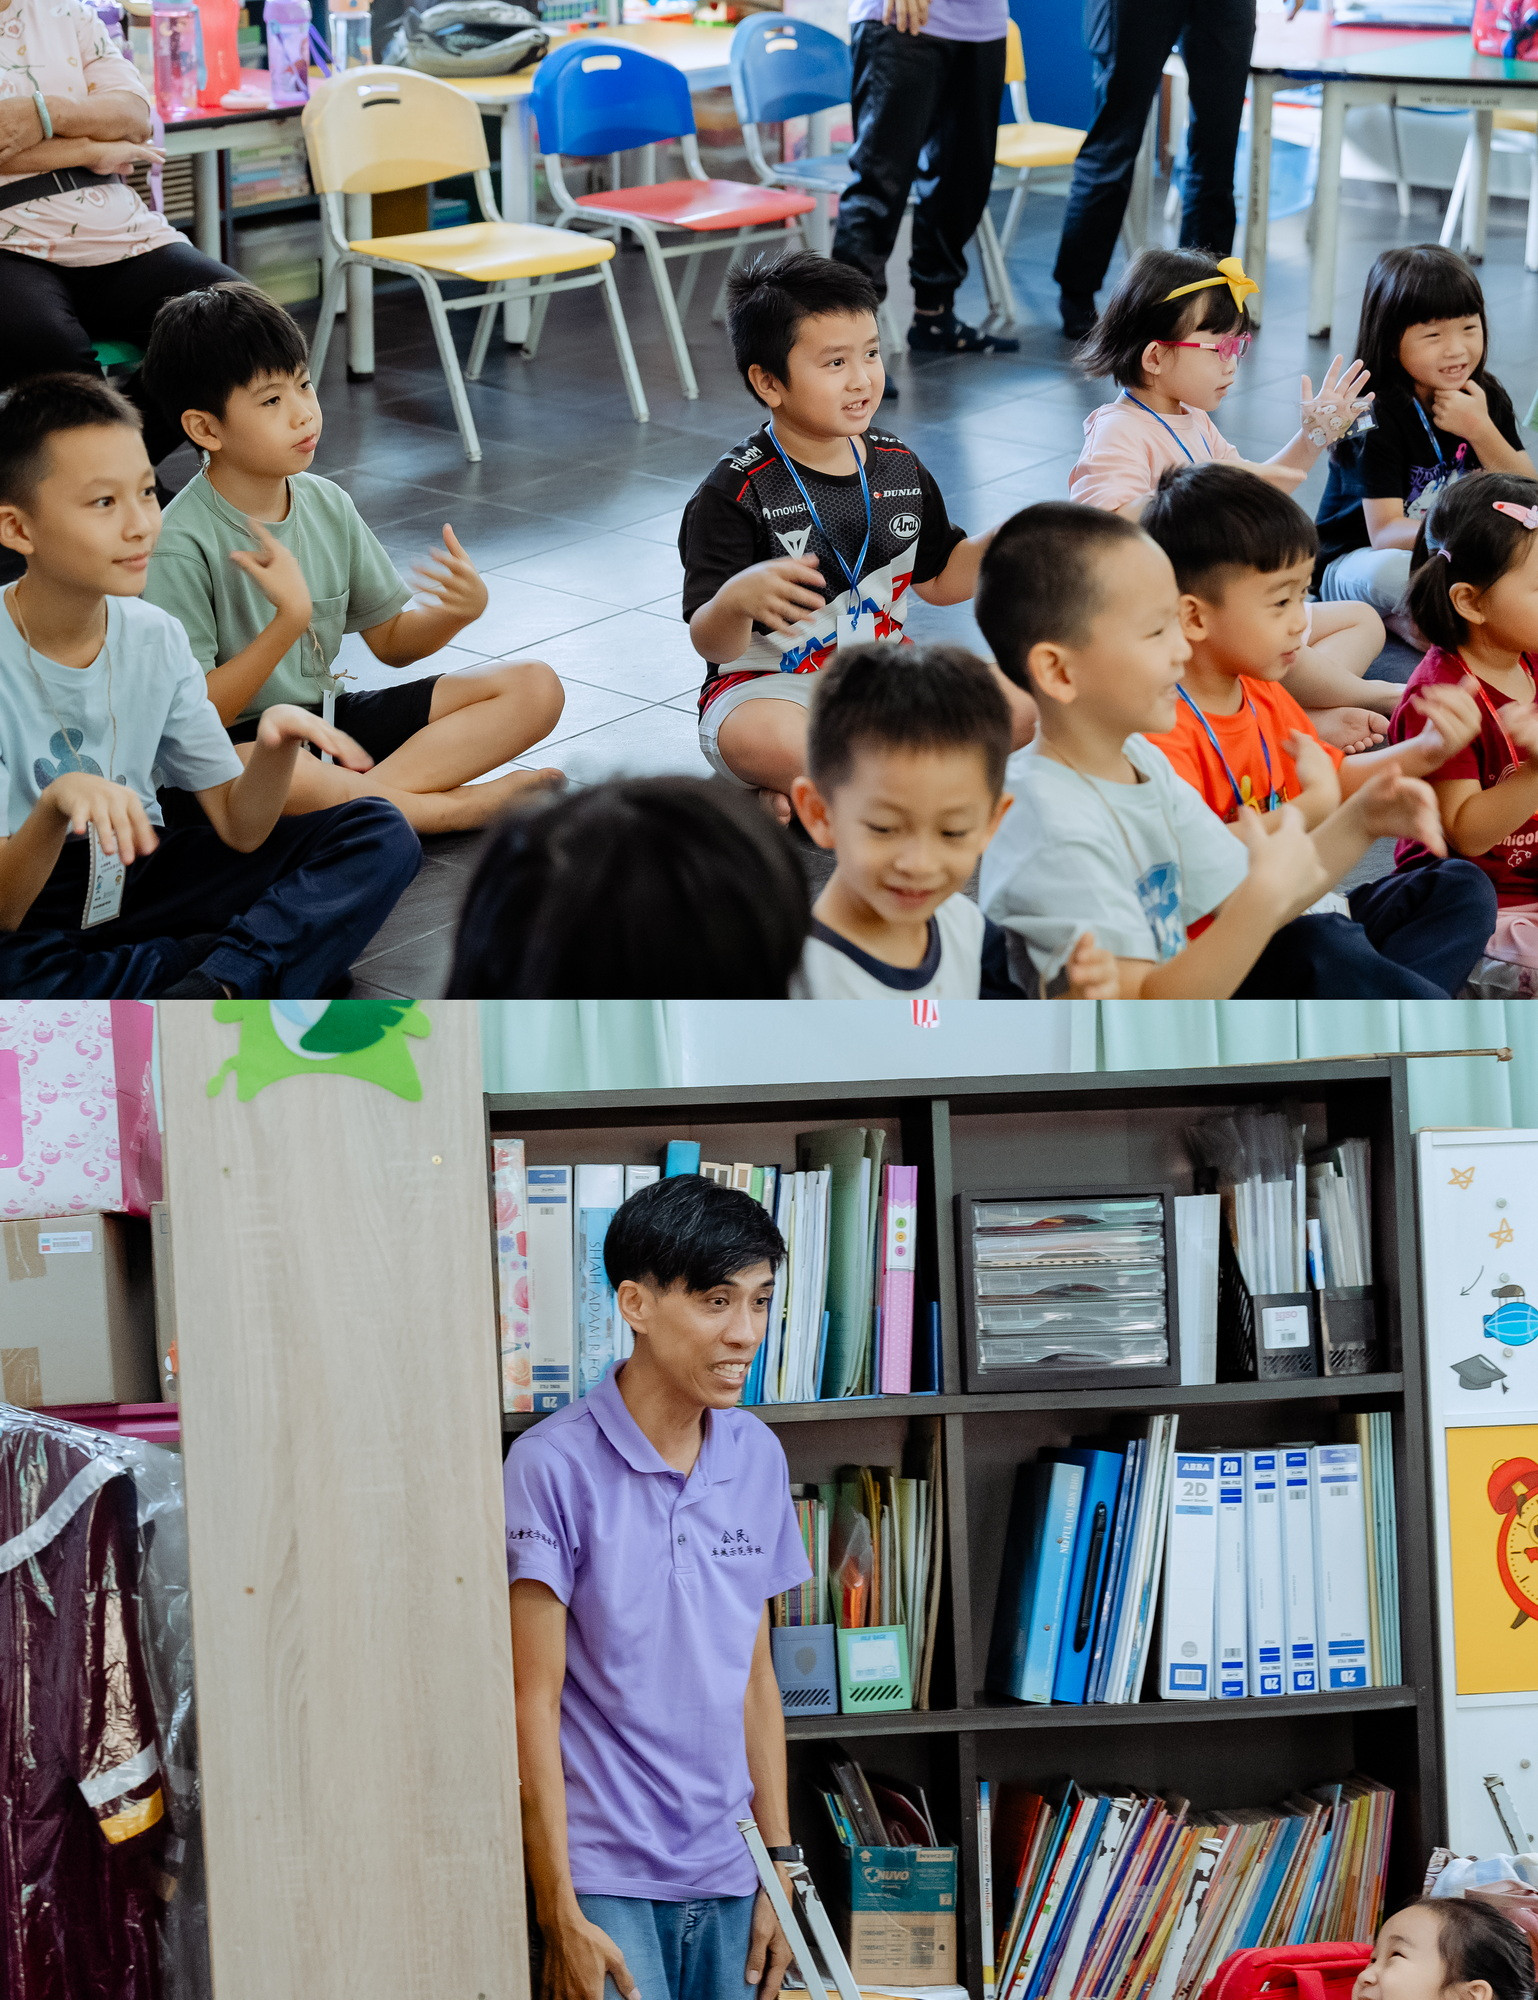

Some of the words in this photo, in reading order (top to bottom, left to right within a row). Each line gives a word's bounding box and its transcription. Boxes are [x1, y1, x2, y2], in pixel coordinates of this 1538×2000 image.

[883, 487, 922, 498] DUNLO
[772, 501, 816, 518] movistr
[894, 516, 917, 533] Arai
[588, 1241, 601, 1285] SHAH
[588, 1289, 601, 1338] ADAM
[1181, 1462, 1211, 1472] ABBA
[1223, 1460, 1239, 1474] 2D
[1183, 1481, 1208, 1497] 2D
[1264, 1677, 1279, 1690] 2D
[1297, 1674, 1312, 1686] 2D
[1340, 1670, 1356, 1683] 2D
